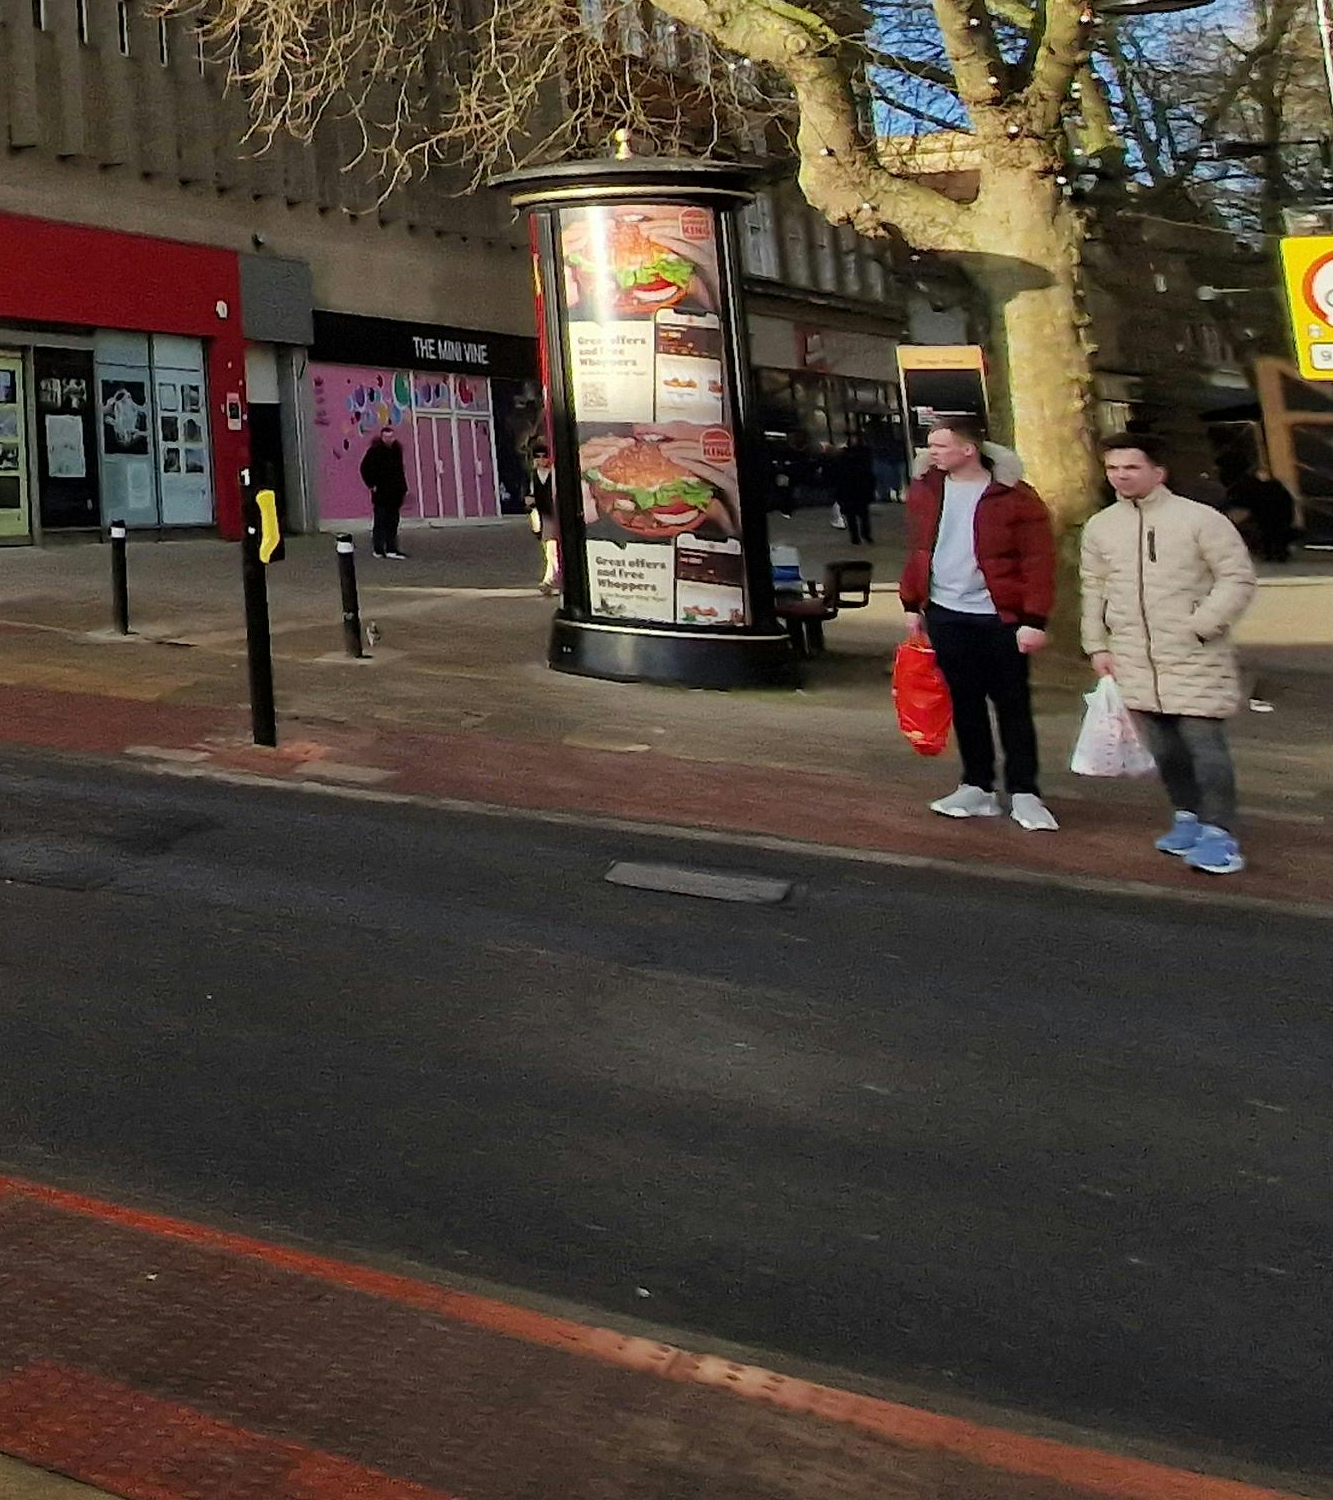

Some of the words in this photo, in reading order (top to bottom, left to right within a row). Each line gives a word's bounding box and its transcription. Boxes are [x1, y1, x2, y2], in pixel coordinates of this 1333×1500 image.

[412, 336, 437, 360] THE
[438, 338, 463, 362] MINI
[463, 341, 490, 365] VINE
[703, 446, 732, 458] KING
[240, 468, 251, 486] 1
[595, 556, 626, 567] Great
[628, 558, 667, 569] offers
[597, 568, 616, 577] and
[619, 568, 645, 580] free
[597, 578, 658, 592] Whoppers
